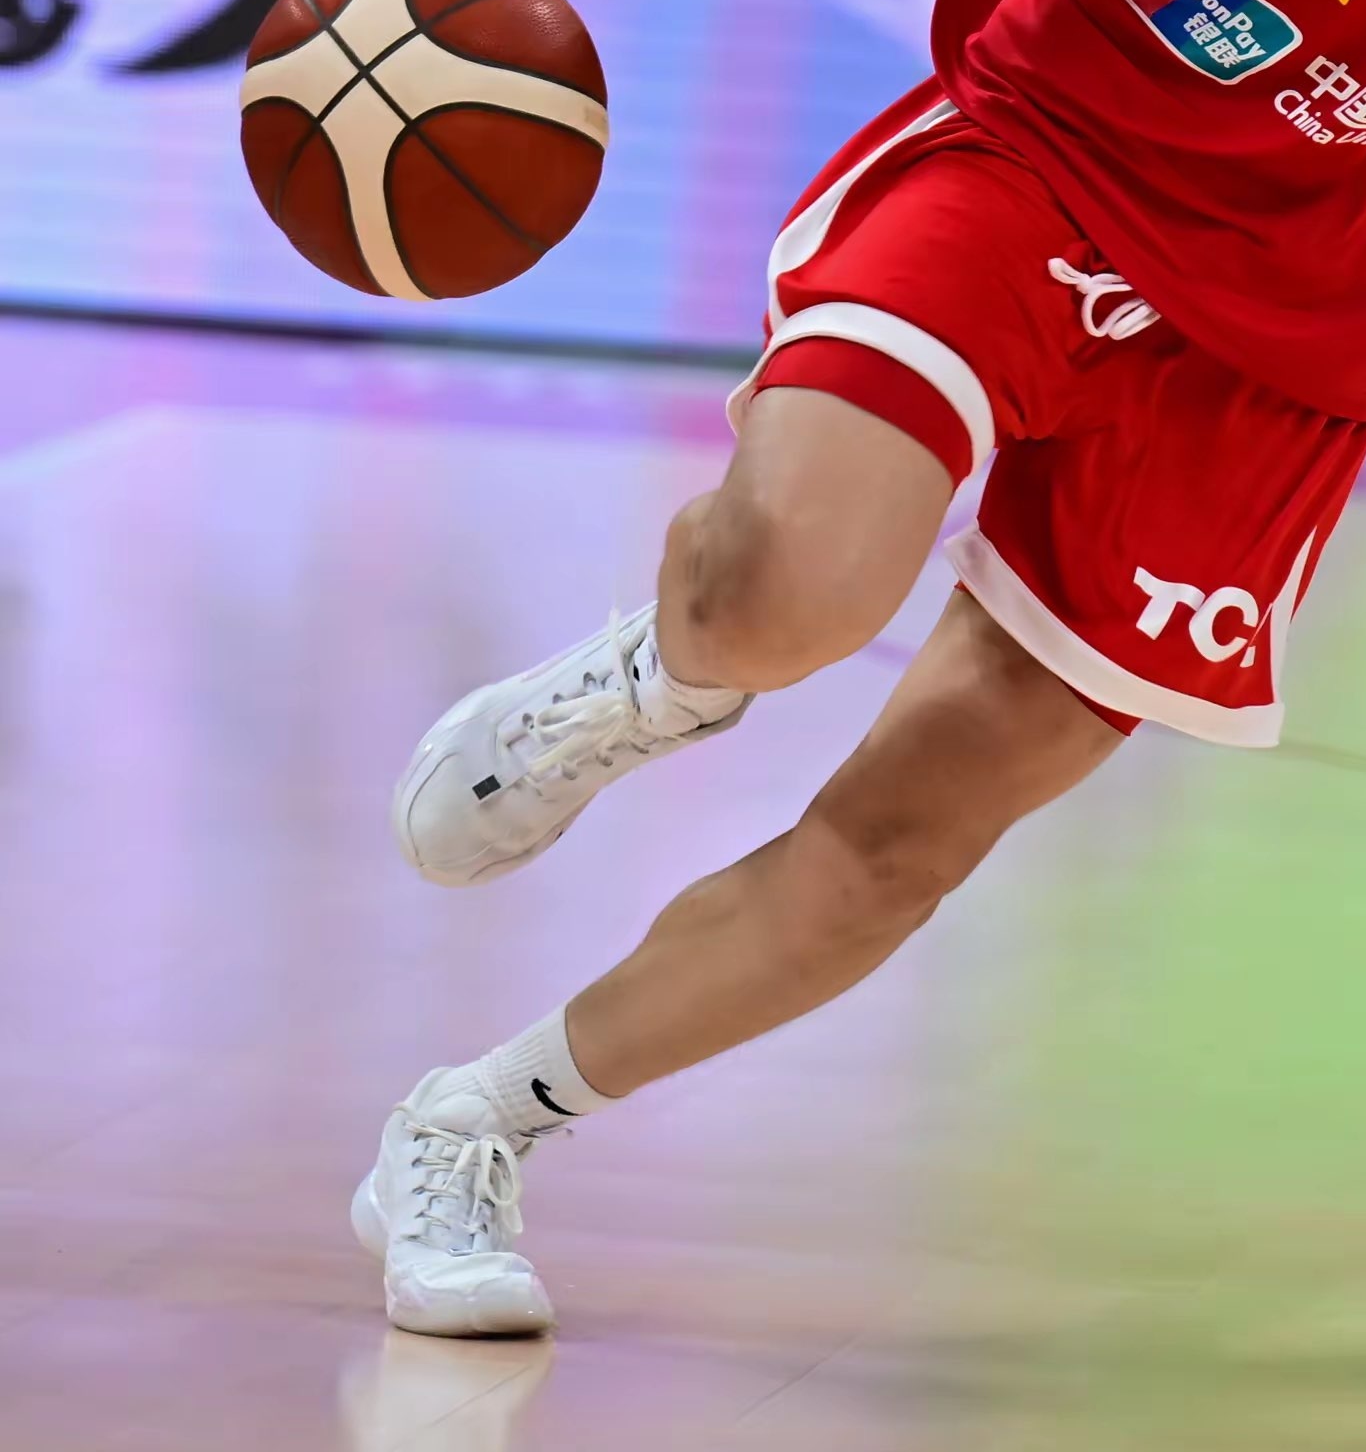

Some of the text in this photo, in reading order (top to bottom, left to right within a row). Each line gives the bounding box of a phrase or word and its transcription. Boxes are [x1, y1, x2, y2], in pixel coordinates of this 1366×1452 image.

[1183, 12, 1240, 68] 银联
[1274, 89, 1335, 144] China
[1133, 566, 1266, 668] TC
